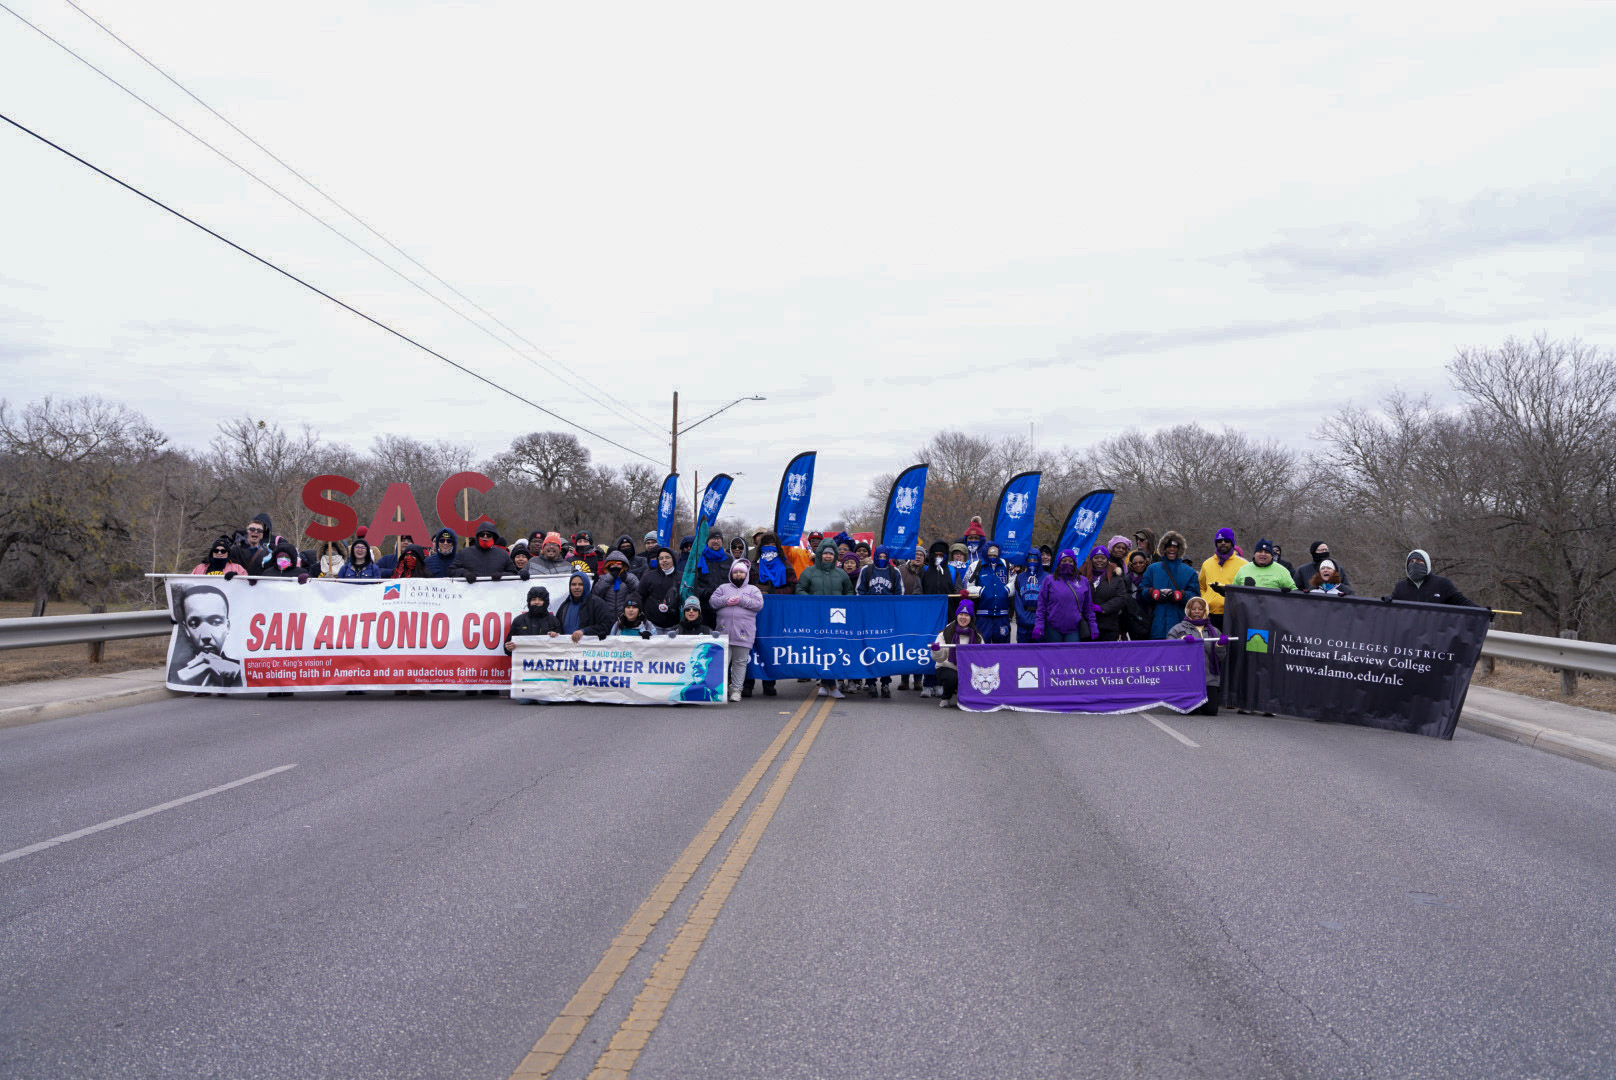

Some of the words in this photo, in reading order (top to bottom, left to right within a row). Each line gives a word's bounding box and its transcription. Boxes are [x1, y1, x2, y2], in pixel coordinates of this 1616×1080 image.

[247, 612, 308, 652] SAN
[313, 611, 449, 651] ANTONIO
[857, 628, 894, 636] DISTRICT
[1281, 633, 1322, 646] ALAMO
[1327, 638, 1389, 654] COLLEGES
[1394, 646, 1456, 661] DISTRICT
[247, 661, 270, 669] sharing
[272, 660, 280, 668] Dr.
[283, 659, 303, 668] King's
[304, 659, 324, 667] vision
[772, 644, 851, 671] Philip's
[859, 642, 933, 666] Colleg
[1280, 643, 1331, 660] Northeast
[1333, 649, 1385, 666] Lakeview
[1388, 656, 1432, 674] College
[265, 669, 297, 681] abiding
[299, 668, 320, 678] faith
[322, 668, 331, 678] in
[333, 668, 371, 678] America
[373, 667, 390, 677] and
[393, 669, 404, 677] an
[407, 667, 454, 677] audacious
[457, 667, 477, 677] faith
[480, 667, 488, 677] in
[491, 667, 505, 677] the
[522, 658, 579, 672] MARTIN
[583, 659, 643, 674] LUTHER
[648, 661, 686, 675] KING
[1049, 667, 1086, 676] ALAMO
[1089, 666, 1141, 674] COLLEGES
[1144, 664, 1193, 673] DISTRICT
[1285, 662, 1404, 686] www.alamo.edu/nlc
[573, 674, 631, 689] MARCH
[1049, 676, 1099, 687] Northwest
[1100, 675, 1124, 685] Vista
[1126, 675, 1161, 687] College
